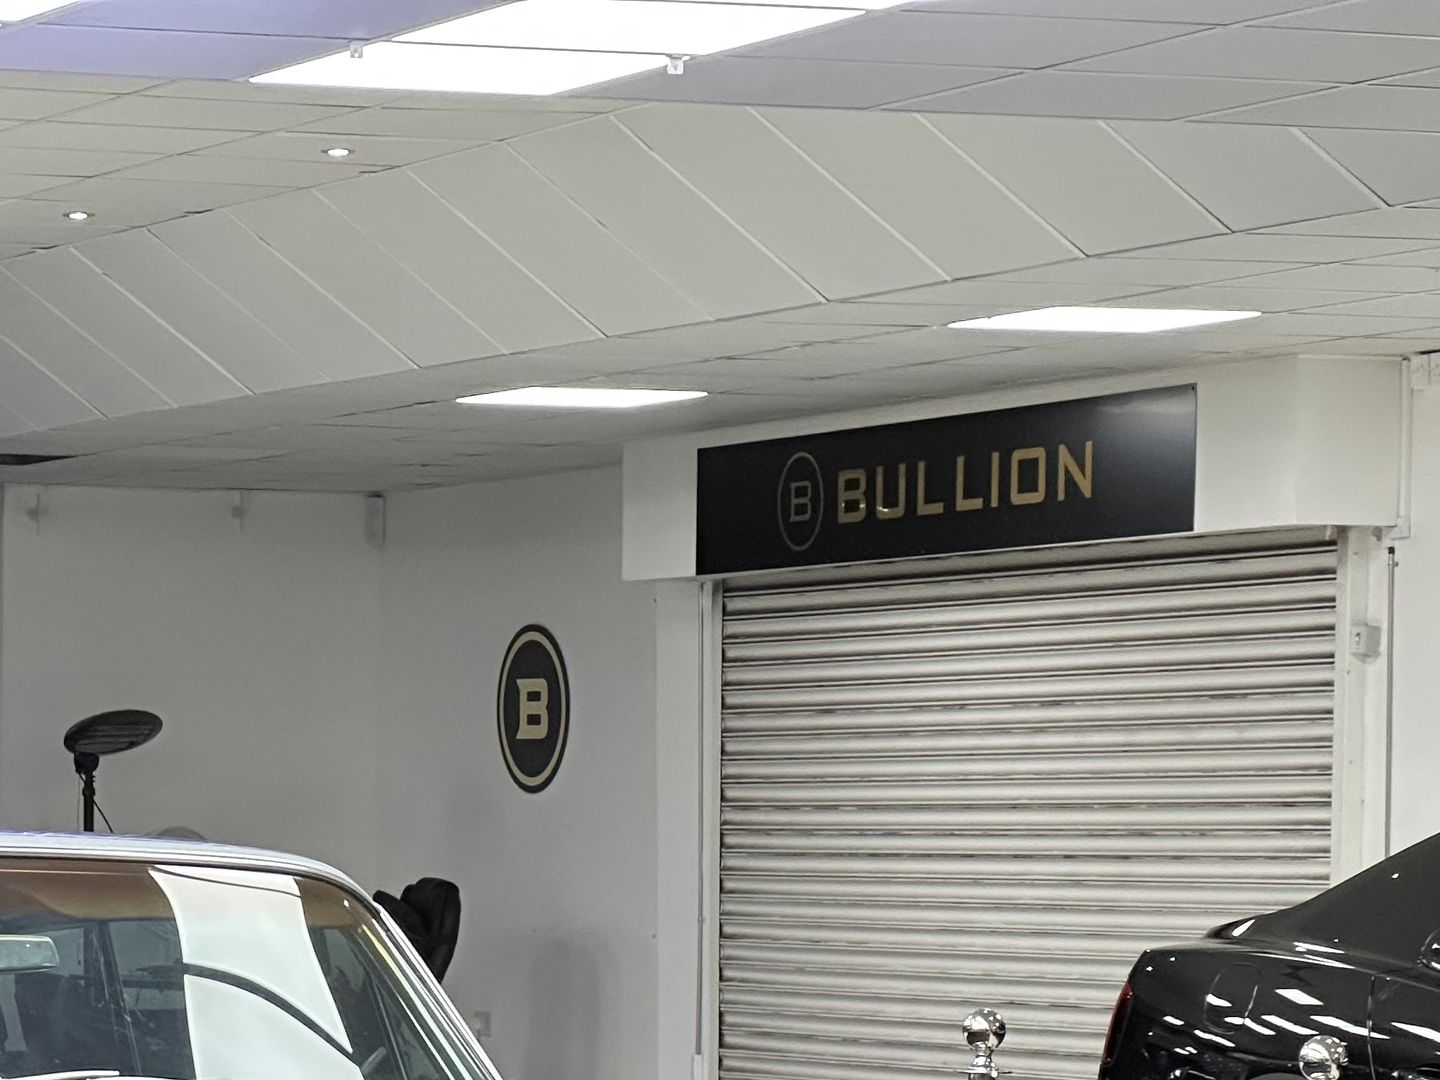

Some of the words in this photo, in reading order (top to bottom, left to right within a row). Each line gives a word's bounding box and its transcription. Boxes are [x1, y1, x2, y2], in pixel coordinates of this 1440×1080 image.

[790, 481, 811, 522] B
[837, 441, 1093, 523] BULLION
[516, 678, 549, 740] B
